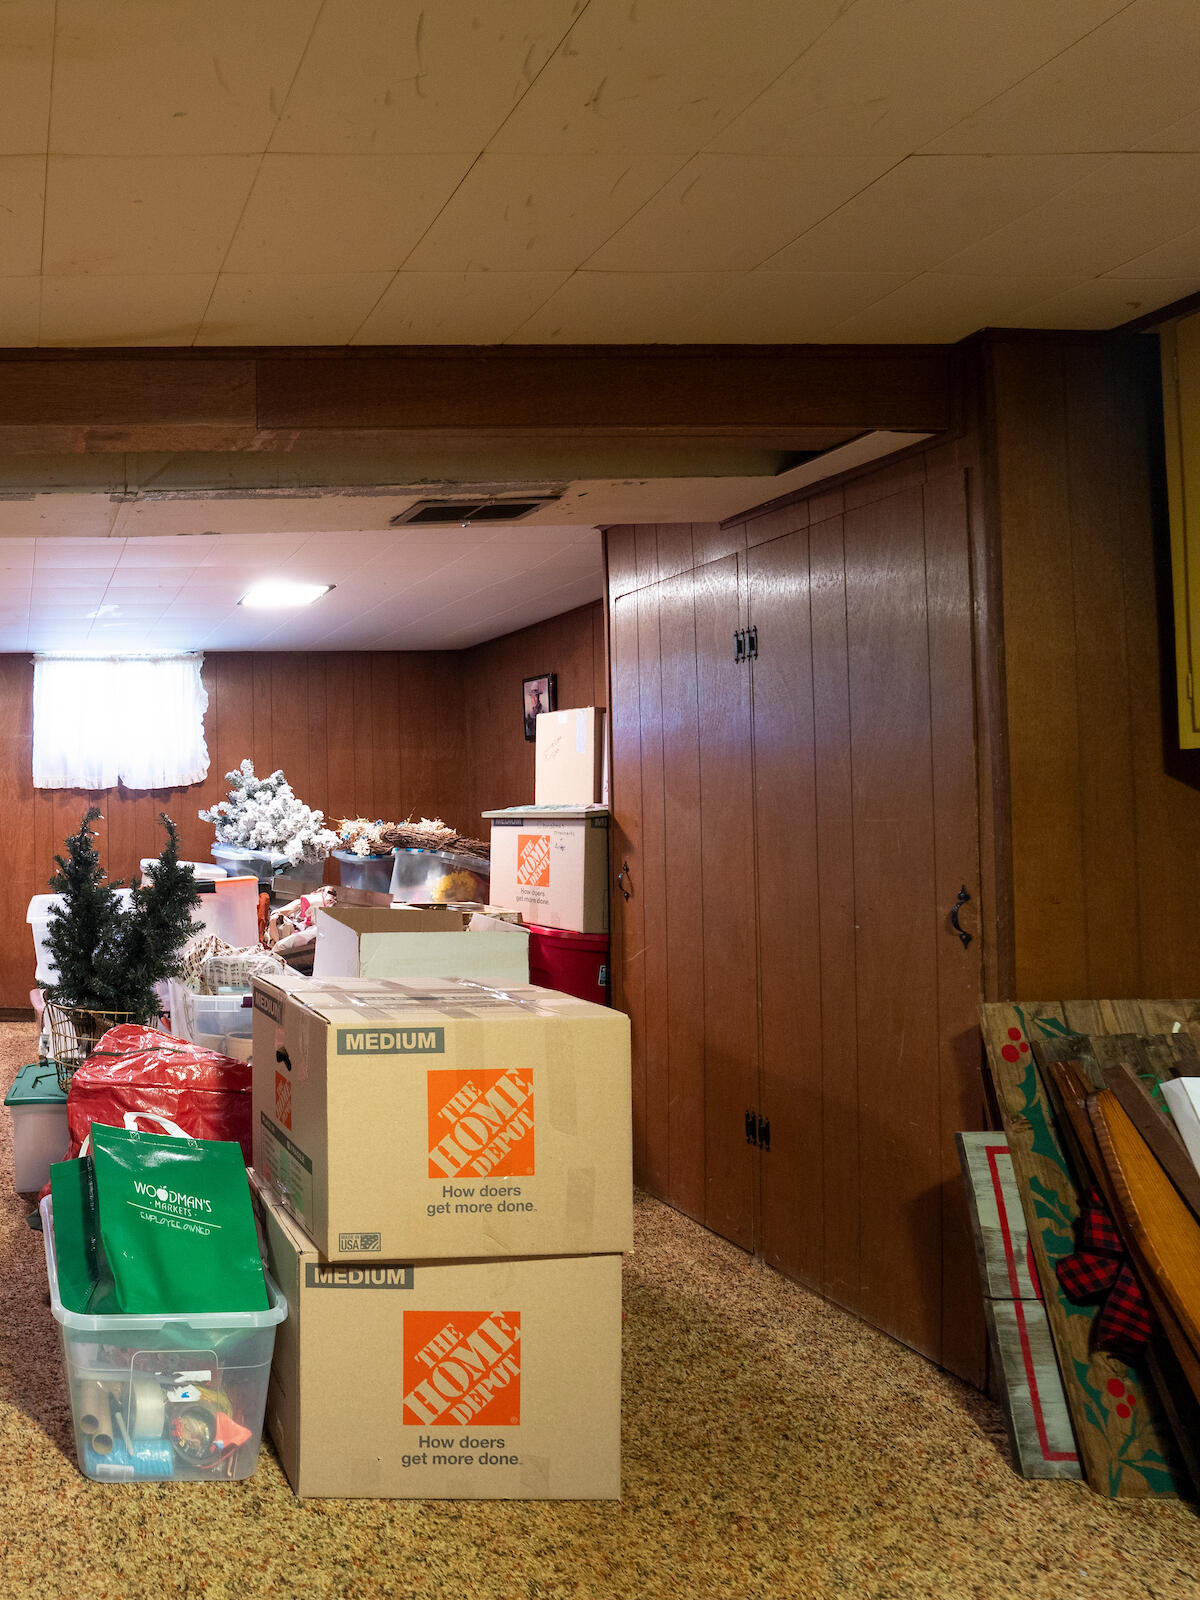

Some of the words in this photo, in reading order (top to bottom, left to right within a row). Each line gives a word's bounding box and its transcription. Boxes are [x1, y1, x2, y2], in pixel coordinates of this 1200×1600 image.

[517, 835, 550, 885] HOME
[520, 840, 535, 859] THE
[530, 854, 550, 885] DEPOT
[345, 1031, 436, 1050] MEDIUM
[437, 1080, 482, 1124] THE
[428, 1068, 534, 1178] HOME
[470, 1107, 534, 1178] DEPOT
[442, 1185, 475, 1198] How
[479, 1185, 521, 1197] doers
[154, 1200, 192, 1217] MARKETS
[427, 1202, 451, 1217] get
[455, 1202, 493, 1213] more
[140, 1211, 182, 1230] EMPLOYEE
[183, 1223, 211, 1236] OWNED
[341, 1240, 359, 1250] USA
[314, 1267, 405, 1285] MEDIUM
[414, 1322, 464, 1368] THE
[403, 1310, 521, 1426] HOME
[449, 1353, 521, 1426] DEPOT
[418, 1435, 454, 1448] How
[459, 1435, 505, 1448] doers
[401, 1453, 428, 1467] get
[432, 1454, 473, 1465] more
